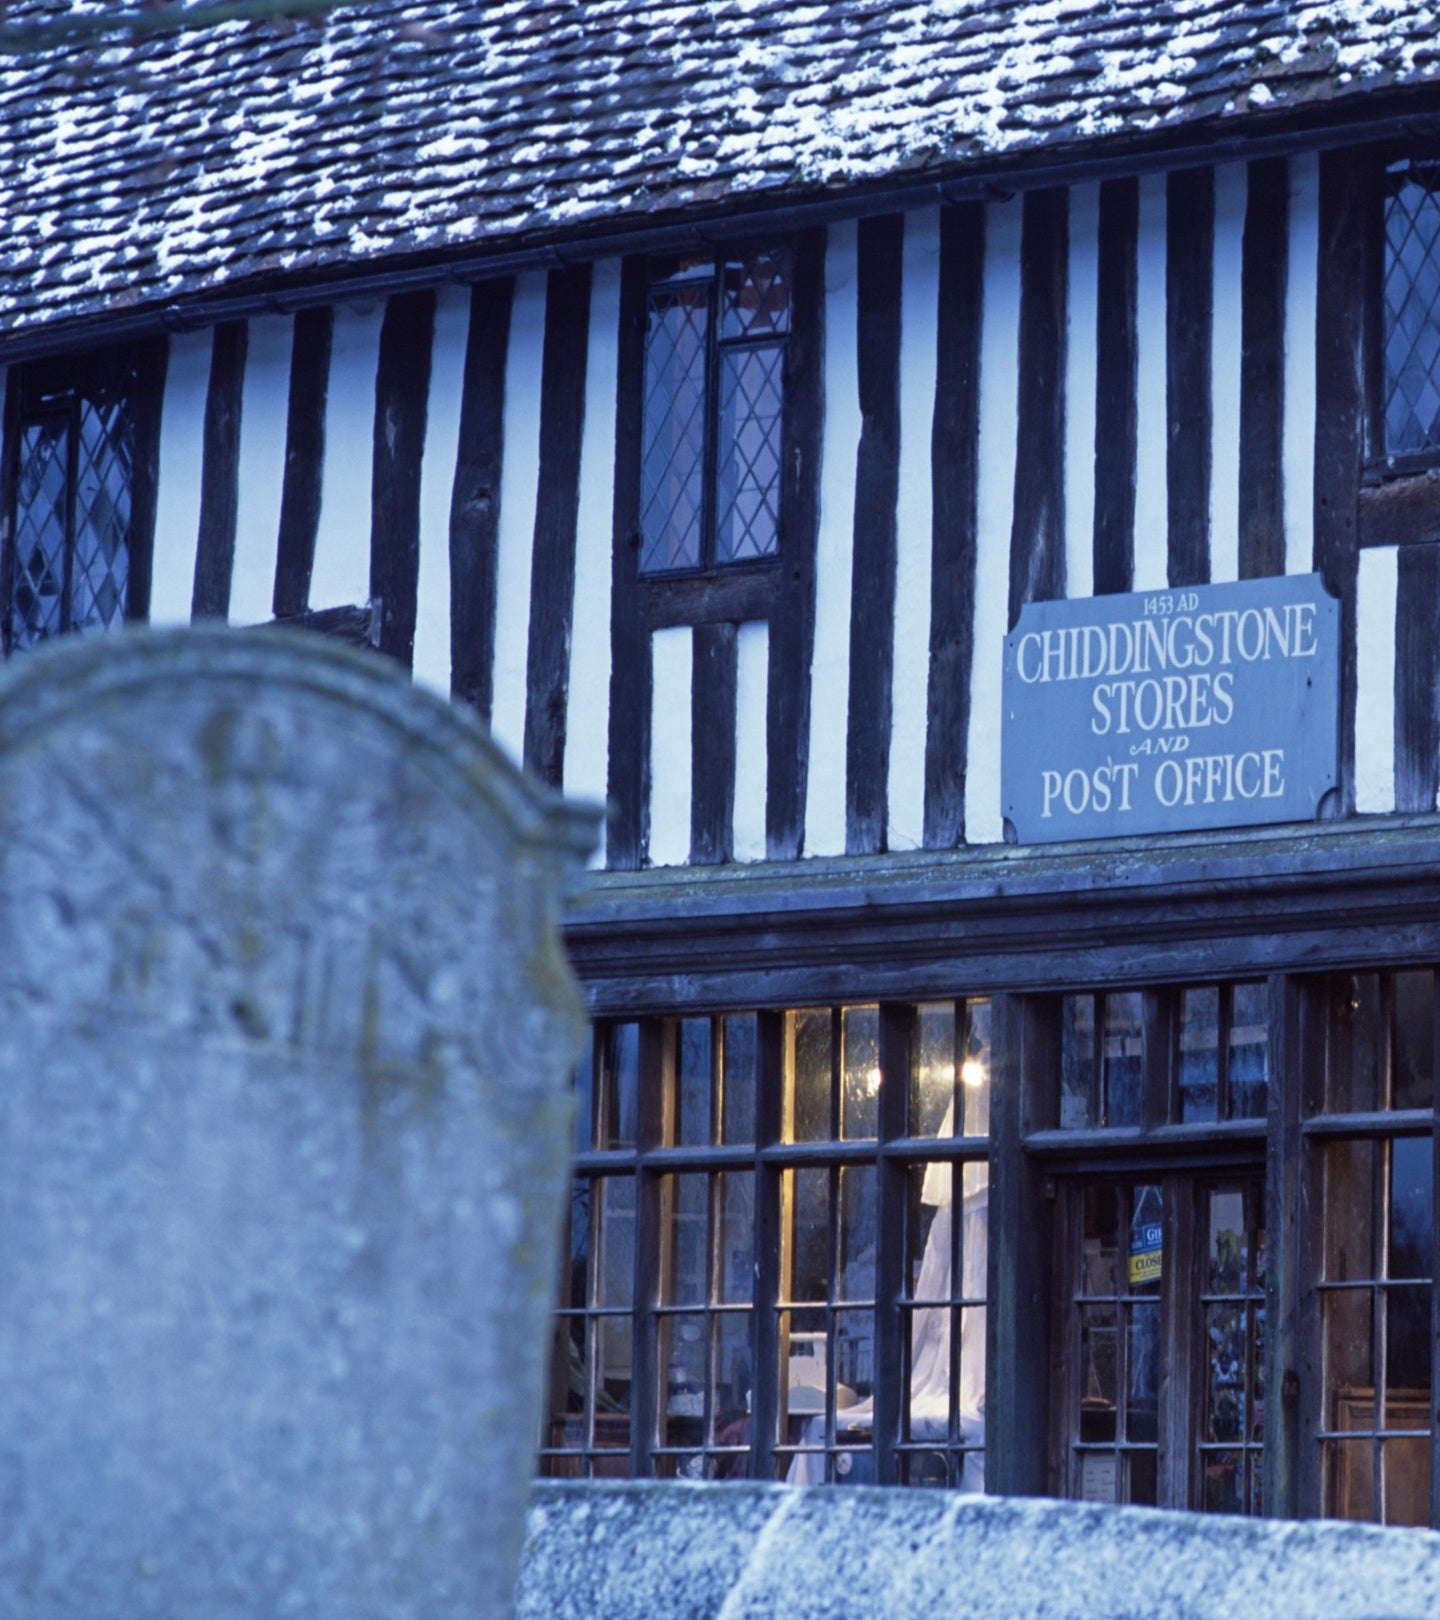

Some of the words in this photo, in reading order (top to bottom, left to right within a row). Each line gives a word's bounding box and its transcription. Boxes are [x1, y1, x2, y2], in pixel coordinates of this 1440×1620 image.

[1143, 595, 1173, 615] 1453
[1176, 593, 1199, 611] AD
[1016, 603, 1318, 683] CHIDDINGSTONE
[1091, 672, 1234, 735] STORES
[1129, 736, 1190, 756] AND
[1041, 763, 1139, 817] POST
[1154, 749, 1285, 807] OFFICE
